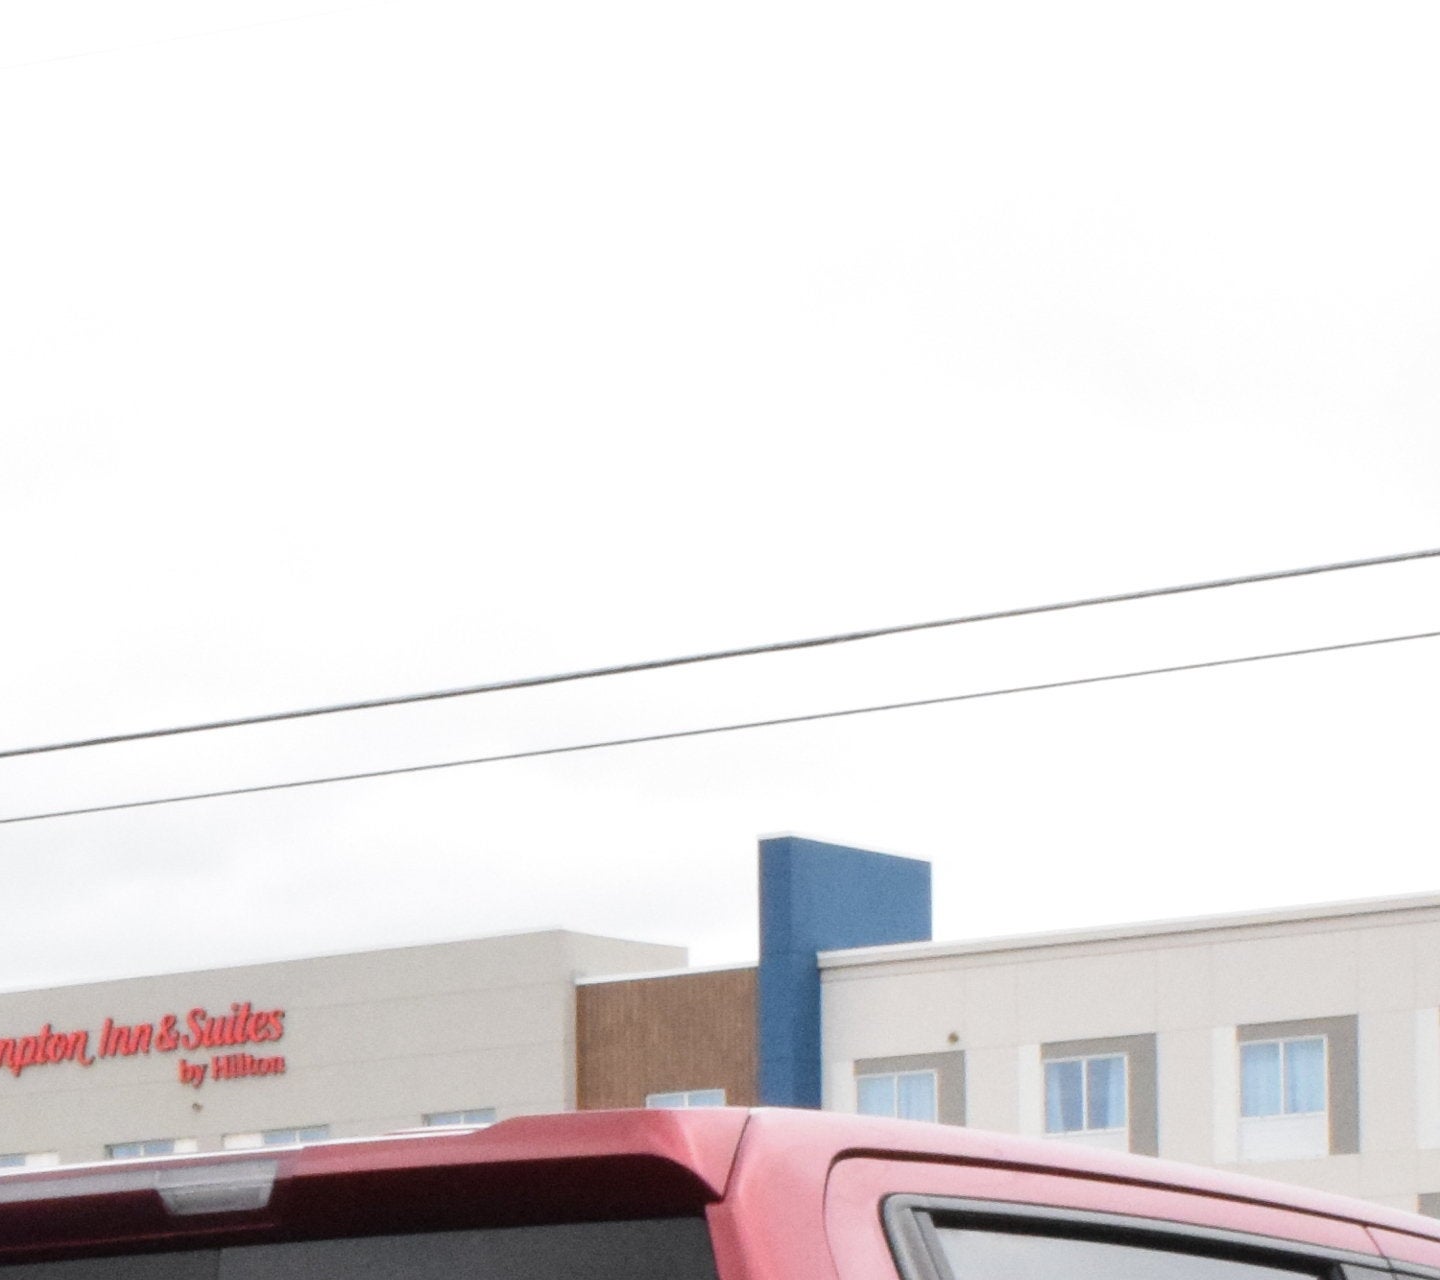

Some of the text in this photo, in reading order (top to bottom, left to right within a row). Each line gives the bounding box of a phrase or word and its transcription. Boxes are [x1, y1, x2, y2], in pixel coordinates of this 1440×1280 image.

[98, 1017, 154, 1058] Inn
[181, 1001, 286, 1048] Suites
[178, 1053, 285, 1089] by Hilton
